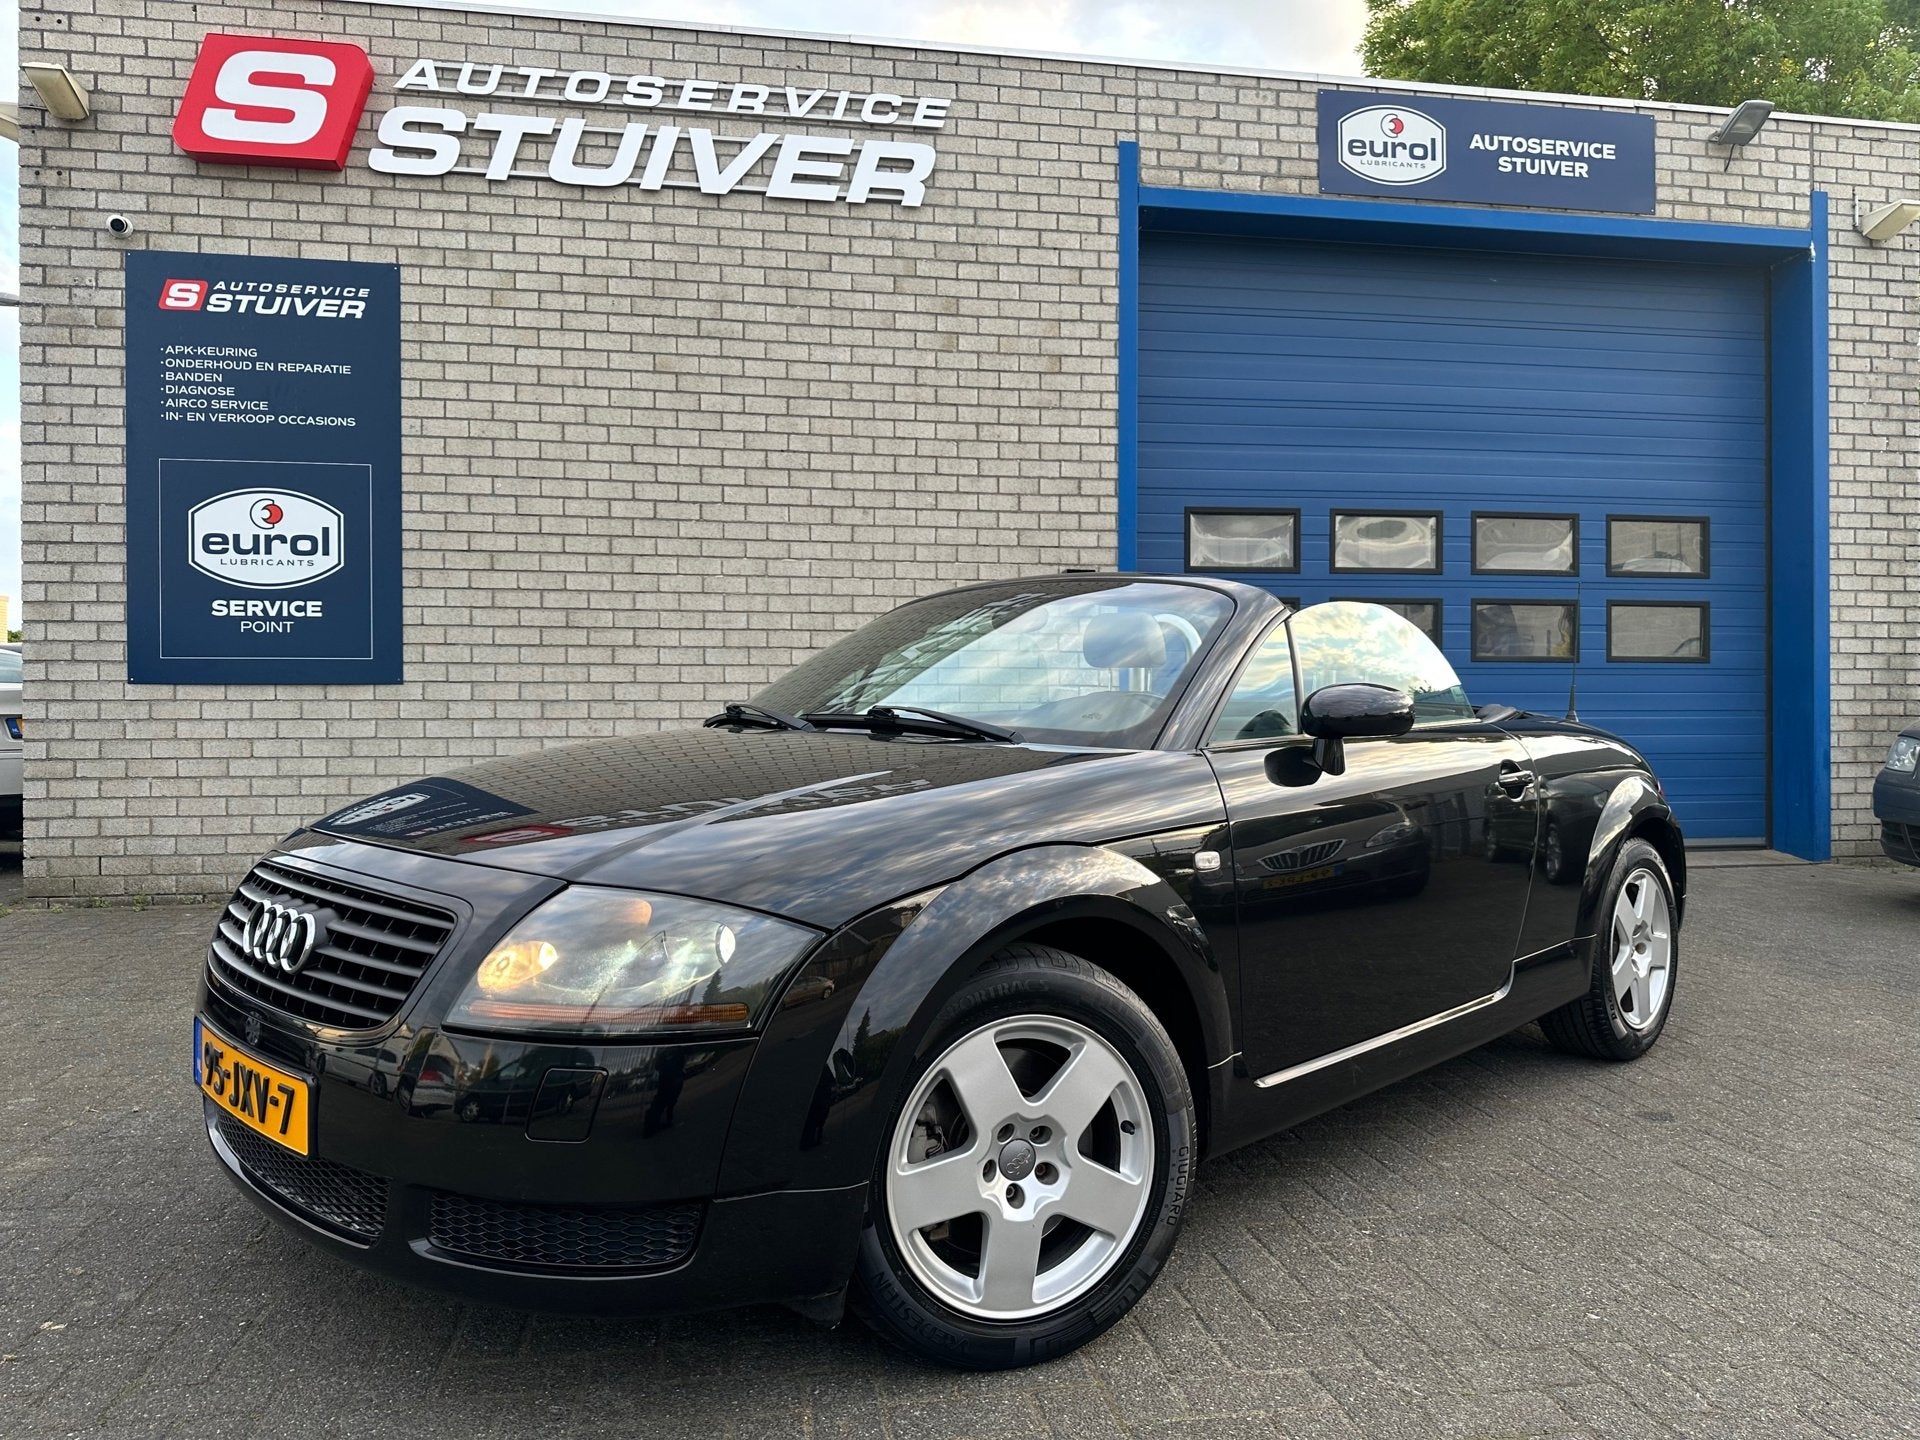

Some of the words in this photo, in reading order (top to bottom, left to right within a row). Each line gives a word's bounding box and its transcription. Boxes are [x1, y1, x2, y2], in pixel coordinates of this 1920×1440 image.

[201, 50, 336, 145] S
[393, 58, 951, 128] AUTOSERVICE
[368, 106, 936, 207] STUIVER
[1347, 137, 1436, 161] eurol
[1469, 133, 1616, 160] AUTOSERVICE
[1360, 159, 1426, 169] LUBRICANTS
[1498, 156, 1589, 178] STUIVER
[165, 283, 201, 307] S
[213, 281, 370, 298] AUTOSERVICE
[206, 294, 366, 319] STUIVER
[165, 345, 258, 357] APK-KEURING
[165, 359, 252, 371] ONDERHOUD
[256, 362, 274, 372] EN
[278, 363, 352, 375] REPARATIE
[165, 372, 223, 382] BANDEN
[165, 385, 235, 396] DIAGNOSE
[165, 399, 208, 409] AIRCO
[211, 400, 269, 411] SERVICE
[165, 412, 183, 421] IN-
[187, 413, 205, 422] EN
[209, 413, 275, 424] VERKOOP
[278, 415, 356, 427] OCCASIONS
[201, 526, 330, 556] eurol
[220, 558, 314, 567] LUBRICANTS
[211, 599, 323, 617] SERVICE
[240, 621, 294, 633] POINT
[204, 1041, 295, 1135] 95-JXV-7
[1166, 1146, 1189, 1225] GIUGIARO
